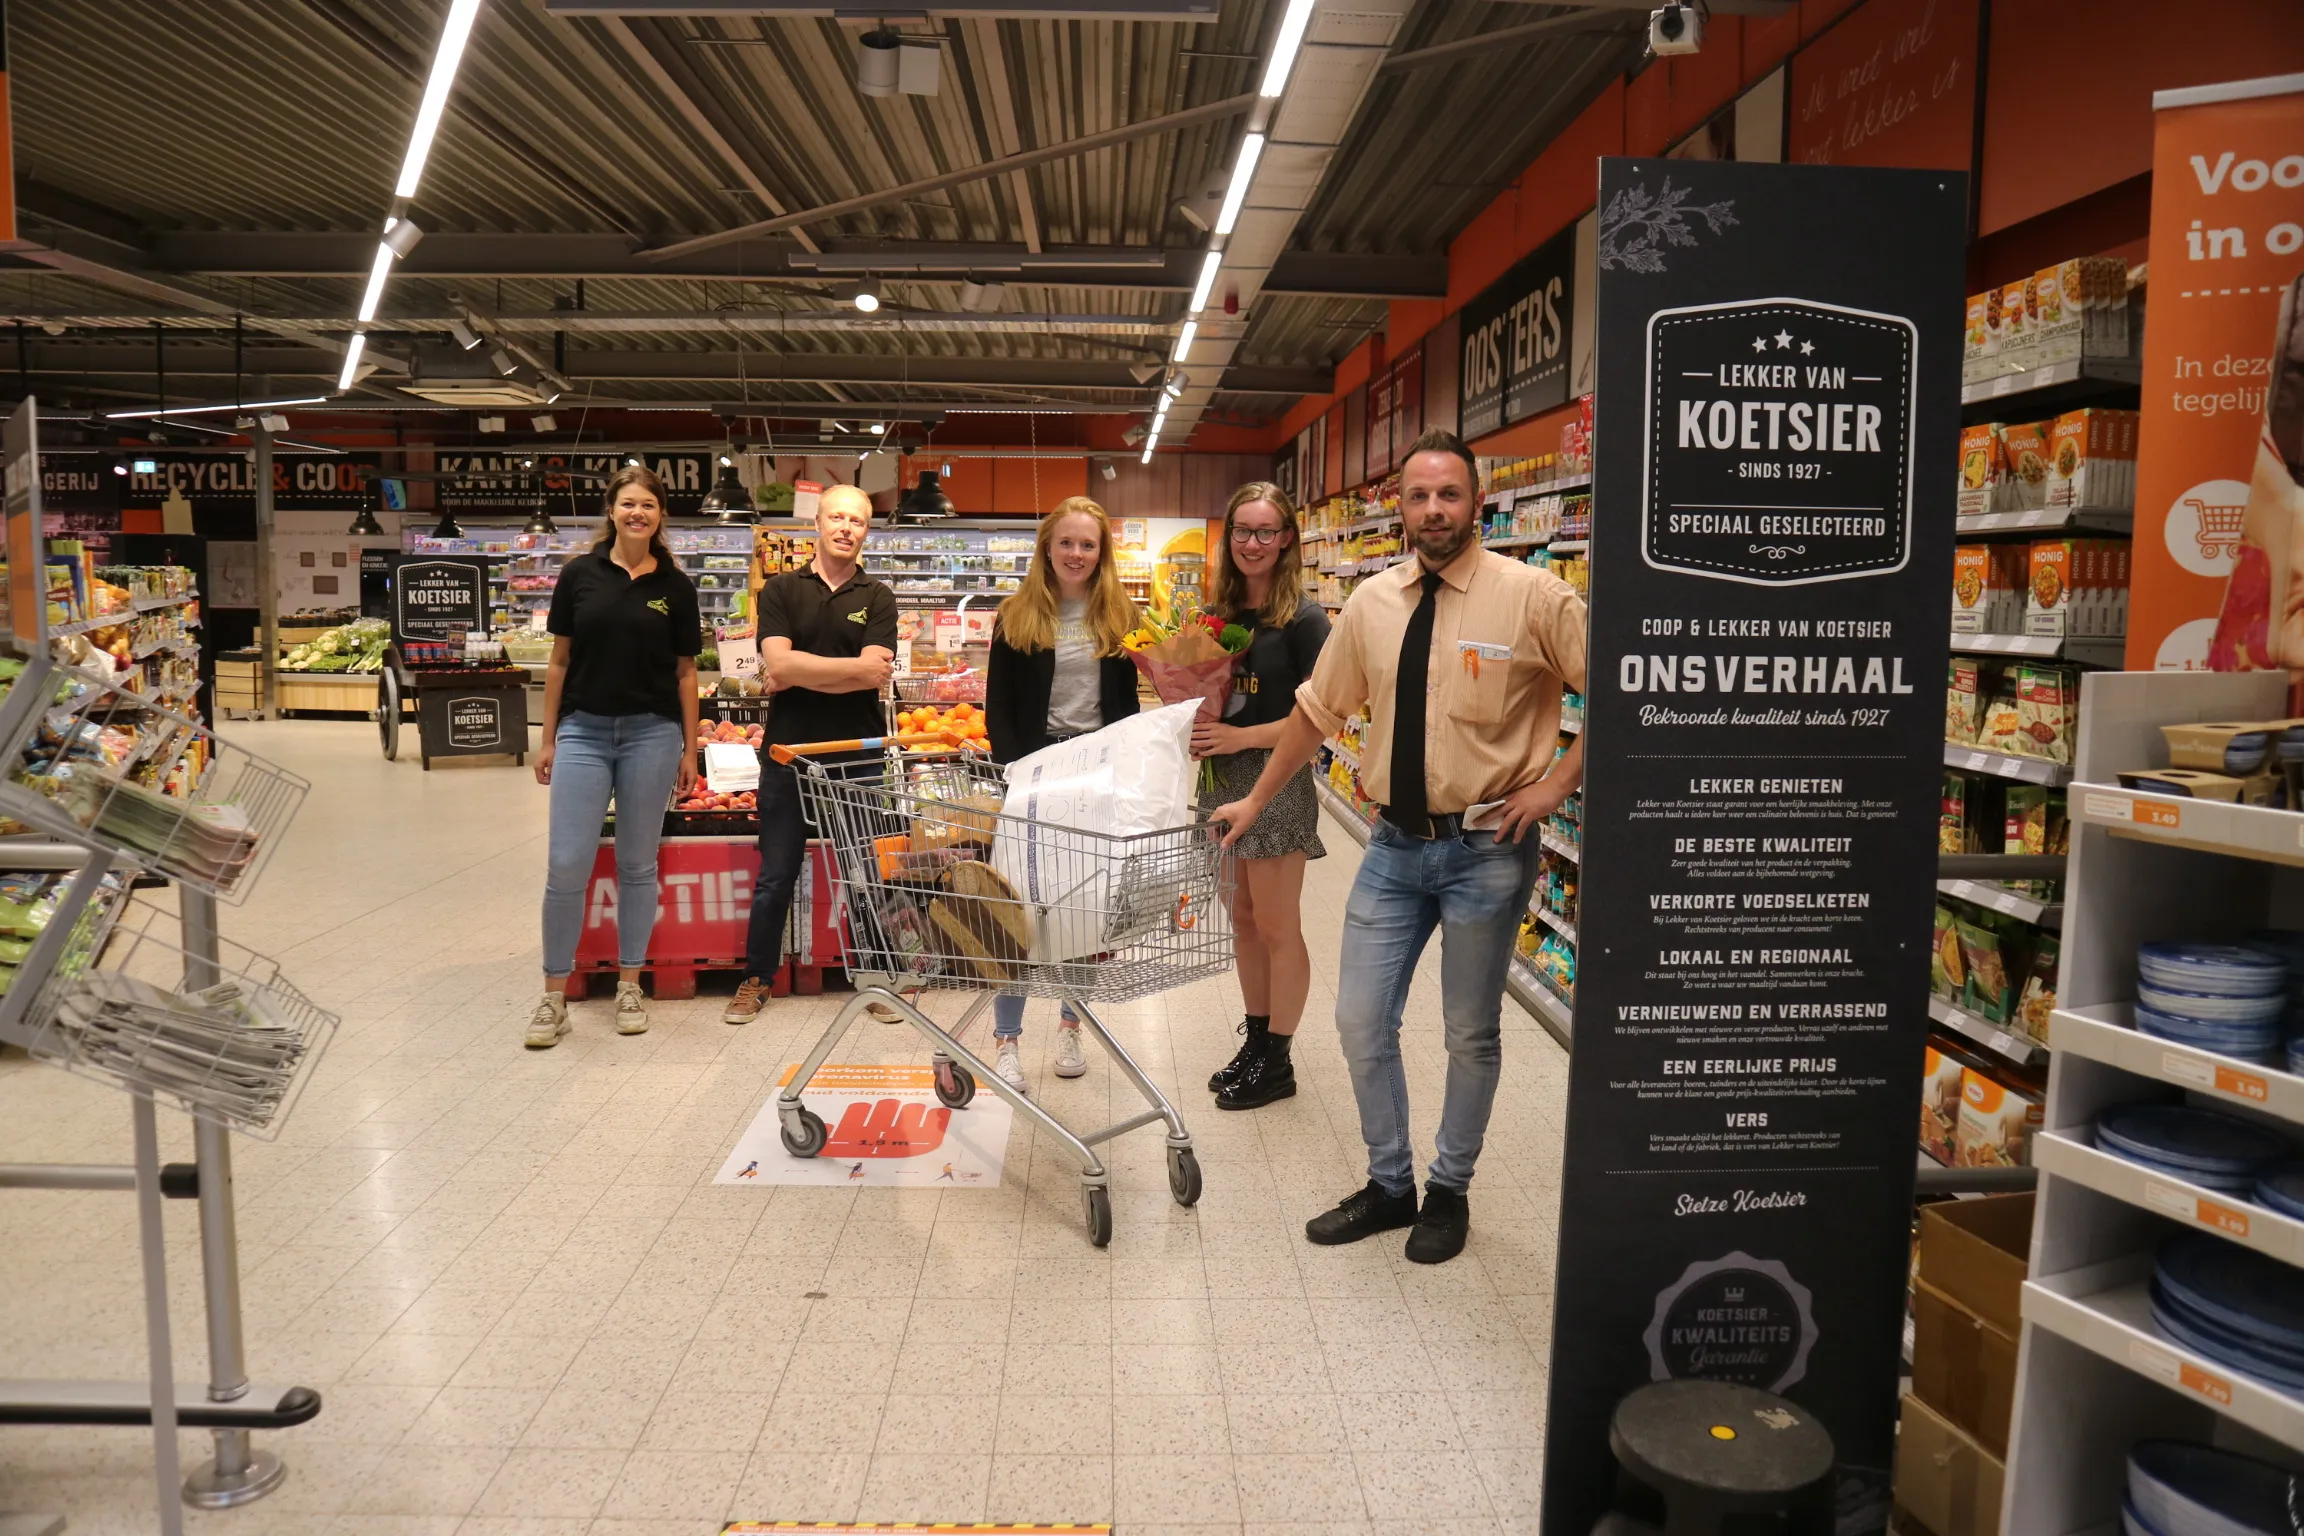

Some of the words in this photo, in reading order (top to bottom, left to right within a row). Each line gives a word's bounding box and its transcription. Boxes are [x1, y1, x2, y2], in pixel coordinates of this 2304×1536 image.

[2186, 219, 2248, 261] in
[2174, 355, 2203, 380] In
[1720, 363, 1796, 388] LEKKER
[1806, 366, 1846, 390] VAN
[2172, 386, 2269, 418] tegelij
[1678, 400, 1883, 453] KOETSIER
[2055, 422, 2083, 437] HONIG
[1964, 436, 1991, 449] HONIG
[2009, 438, 2039, 451] HONIG
[585, 457, 699, 490] KLAR
[1739, 462, 1782, 480] SINDS
[1787, 463, 1821, 481] 1927
[40, 472, 98, 491] GERIJ
[1669, 514, 1753, 534] SPECIAAL
[1760, 516, 1886, 537] GESELECTEERD
[1958, 556, 1984, 566] HONIG
[2034, 551, 2064, 563] HONIG
[420, 579, 444, 587] LEKKER
[408, 590, 471, 604] KOETSIER
[407, 621, 433, 629] SPECIAAL
[1642, 616, 1682, 637] COOP
[1690, 616, 1700, 637] &
[1708, 616, 1770, 637] LEKKER
[1778, 617, 1808, 638] VAN
[1816, 617, 1891, 639] KOETSIER
[1620, 655, 1706, 693] ONS
[1715, 656, 1914, 694] VERHAAL
[455, 714, 494, 725] KOETSIER
[1639, 705, 1728, 726] Bekroonde
[1730, 702, 1802, 726] kwaliteit
[1803, 703, 1849, 726] sinds
[1848, 703, 1889, 727] 1927
[1690, 779, 1755, 793] LEKKER
[1761, 779, 1843, 793] GENIETEN
[1676, 800, 1704, 808] Koetsier
[1628, 810, 1663, 821] producten
[1664, 810, 1682, 818] haalt
[1690, 810, 1710, 818] iedere
[1712, 810, 1725, 818] keer
[1675, 838, 1696, 853] DE
[1703, 838, 1756, 853] BESTE
[1763, 838, 1852, 853] KWALITEIT
[1686, 859, 1707, 870] goede
[1708, 859, 1739, 867] kwaliteit
[1754, 859, 1765, 867] het
[1766, 859, 1792, 869] product
[1651, 894, 1735, 910] VERKORTE
[1744, 893, 1869, 909] VOEDSELKETEN
[1660, 949, 1724, 965] LOKAAL
[1731, 949, 1753, 964] EN
[1761, 948, 1853, 964] REGIONAAL
[1618, 1004, 1743, 1020] VERNIEUWEND
[1749, 1004, 1772, 1019] EN
[1778, 1003, 1887, 1018] VERRASSEND
[1664, 1060, 1696, 1075] EEN
[1704, 1058, 1782, 1074] EERLIJKE
[1790, 1058, 1836, 1073] PRIJS
[1725, 1112, 1768, 1127] VERS
[1674, 1193, 1728, 1216] Sietze
[1733, 1190, 1808, 1213] Koetsier
[1697, 1308, 1769, 1322] KOETSIER
[1671, 1326, 1791, 1344] KWALITEITS
[1689, 1346, 1769, 1372] Garantie
